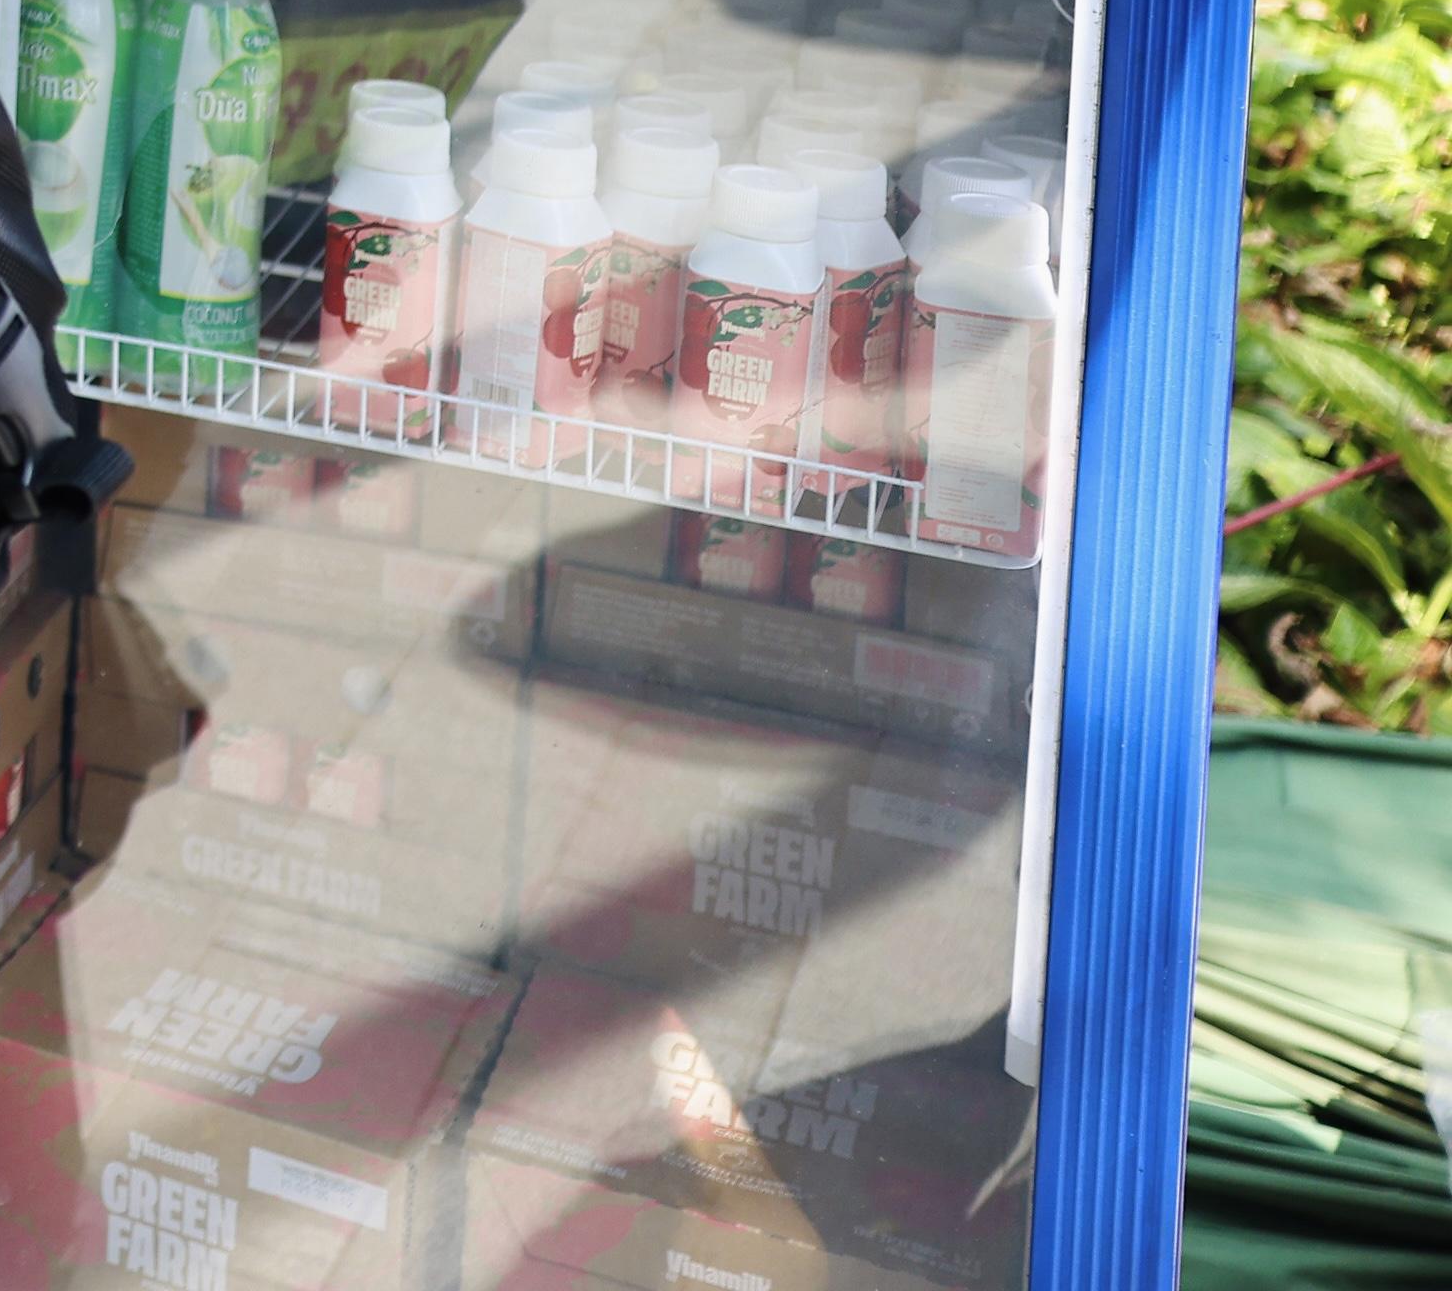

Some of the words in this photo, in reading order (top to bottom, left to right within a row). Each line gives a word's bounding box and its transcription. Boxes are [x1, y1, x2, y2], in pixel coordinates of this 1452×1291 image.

[343, 275, 402, 308] GREEN
[706, 348, 774, 384] GREEN
[708, 373, 770, 407] FARM
[687, 811, 837, 890] GREEN
[691, 860, 824, 941] FARM
[108, 995, 324, 1084] GREEN
[145, 966, 341, 1052] FARM
[652, 1069, 859, 1160] FARM
[100, 1159, 239, 1252] GREEN
[104, 1213, 231, 1291] FARM
